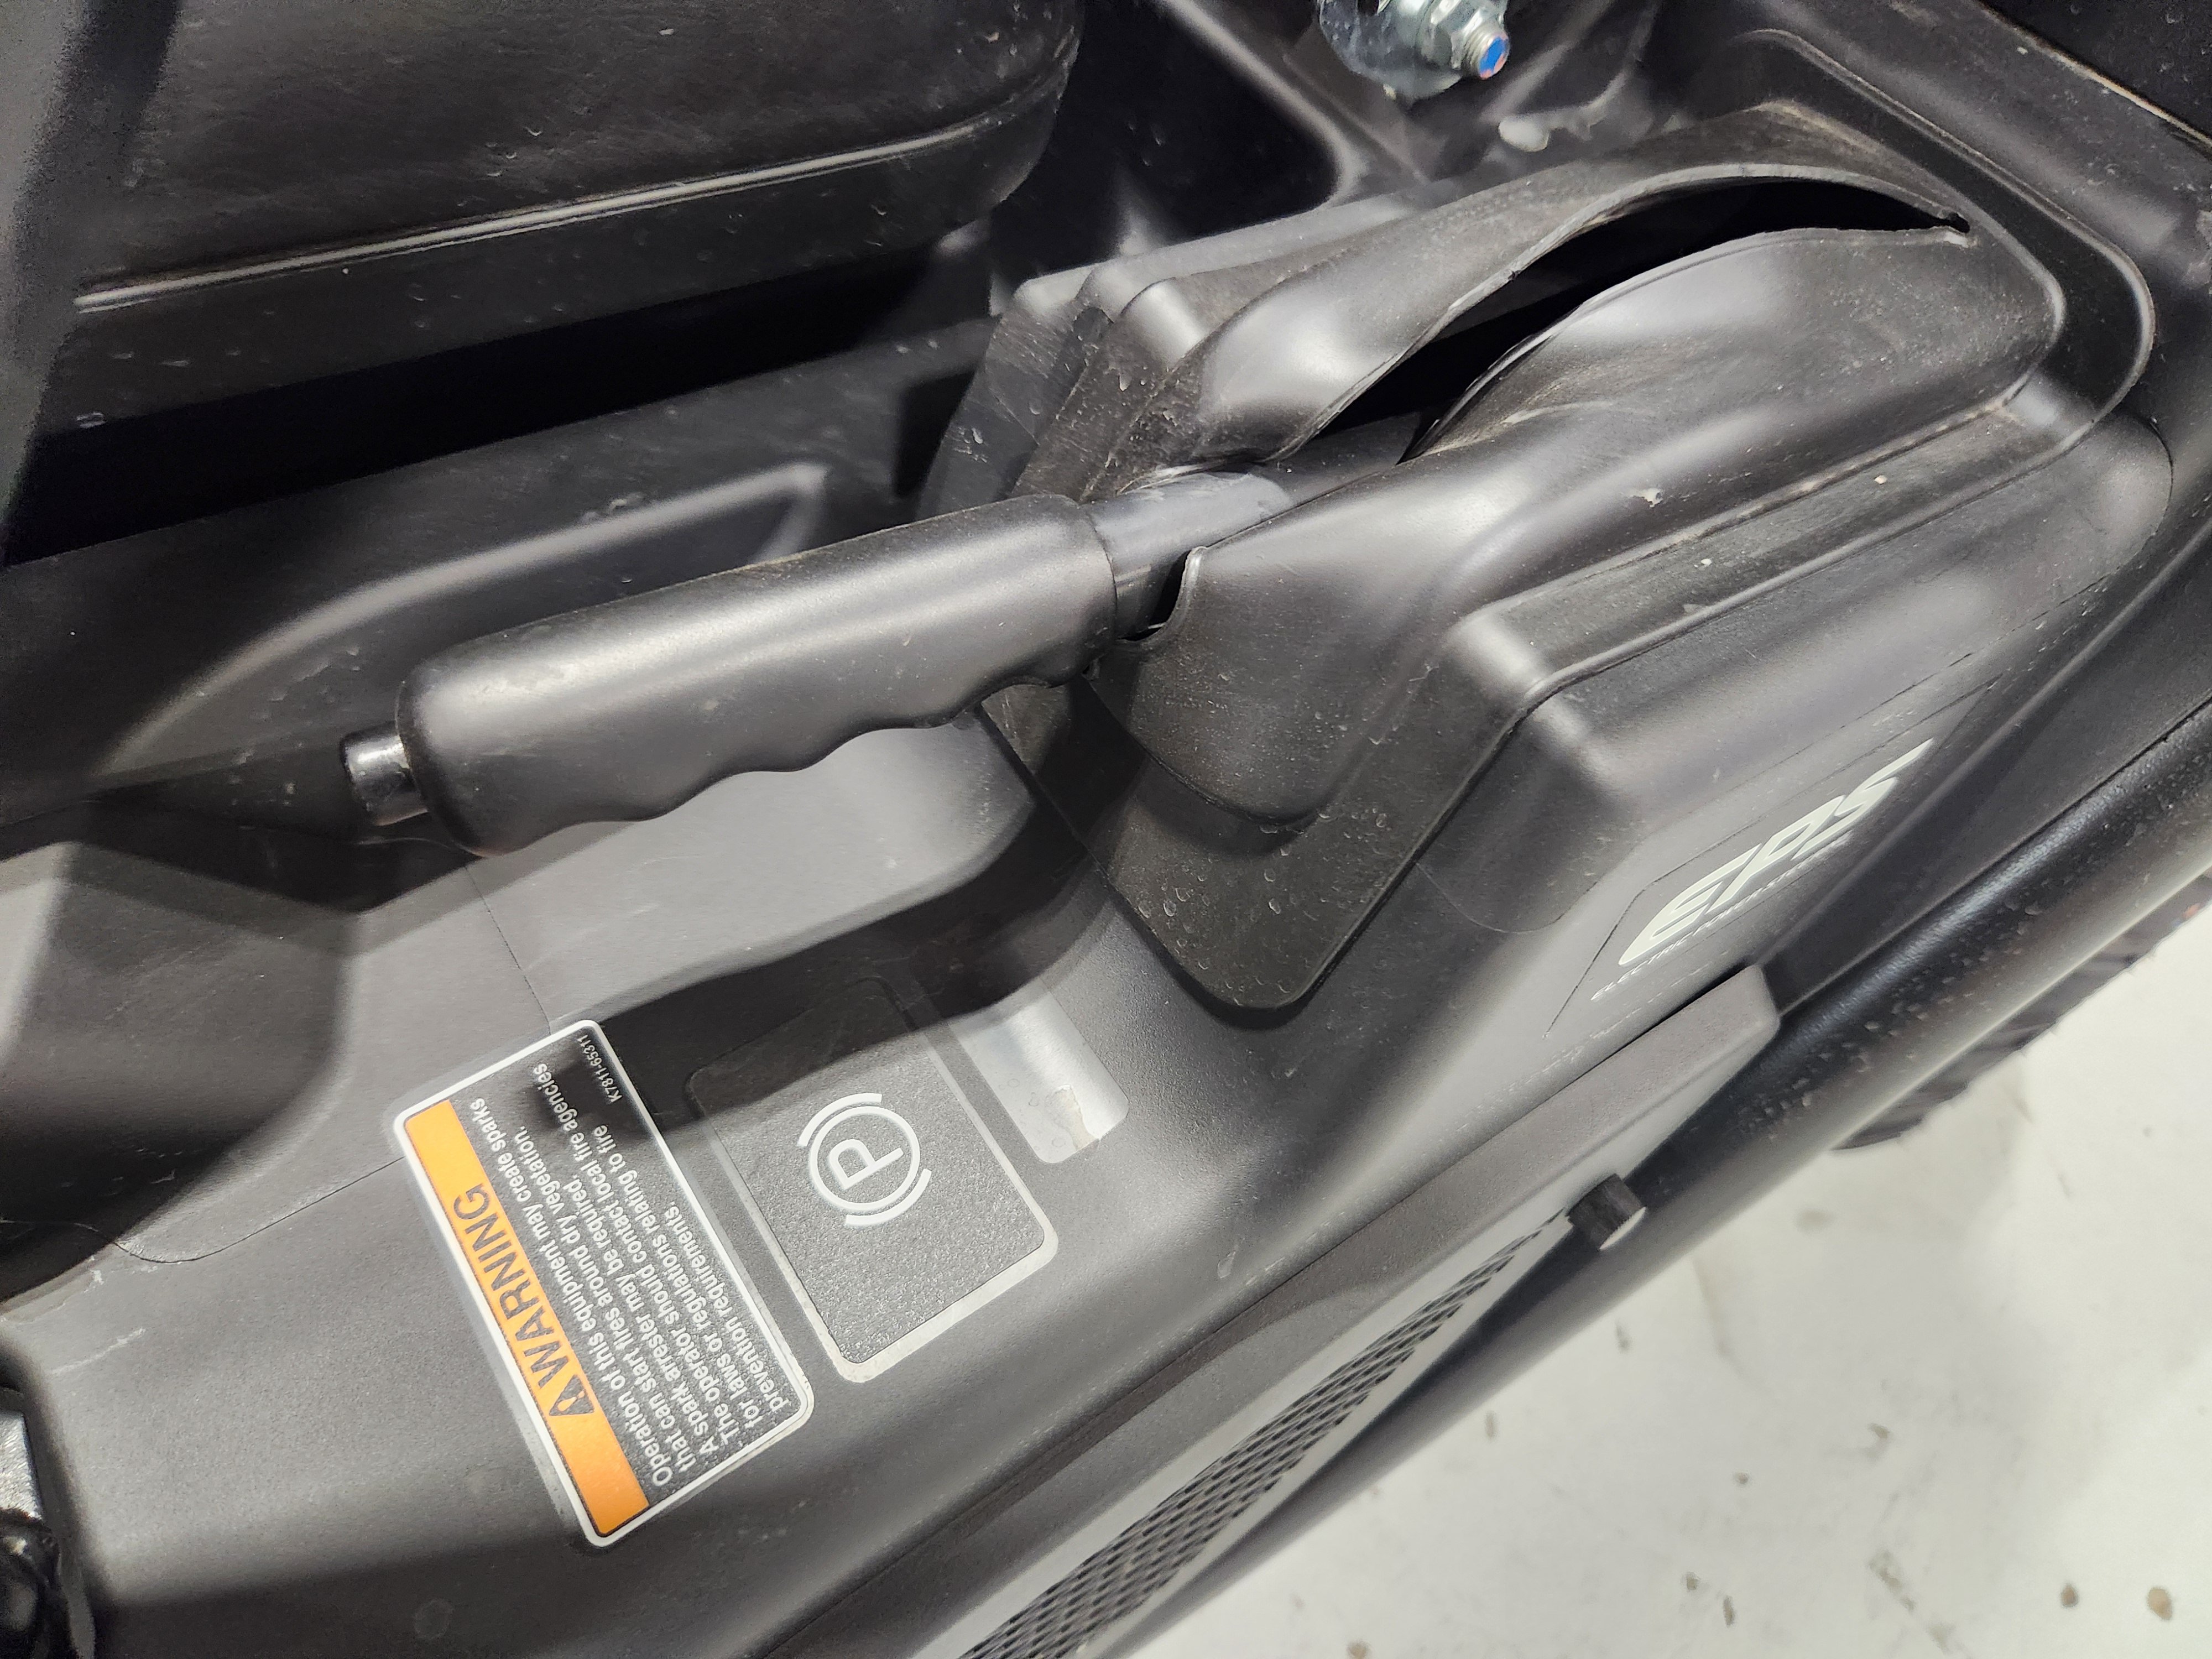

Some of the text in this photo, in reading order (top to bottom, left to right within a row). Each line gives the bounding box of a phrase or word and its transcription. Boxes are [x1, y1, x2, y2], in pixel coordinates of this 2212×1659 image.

[1590, 931, 1693, 1001] ELECTRIC
[1618, 737, 1934, 966] EPS
[576, 1034, 622, 1102] K7811-65311
[452, 1182, 570, 1389] WARNING
[469, 1098, 673, 1485] Operation of this equipment may create sparks
[513, 1126, 696, 1472] that can start fires around dry vegetation.
[531, 1062, 739, 1444] The operator should contact local fire agencies
[561, 1174, 719, 1455] A spark arrester may be required.
[592, 1125, 763, 1428] for laws or regulations relating to fire
[663, 1201, 789, 1412] prevention requirements.
